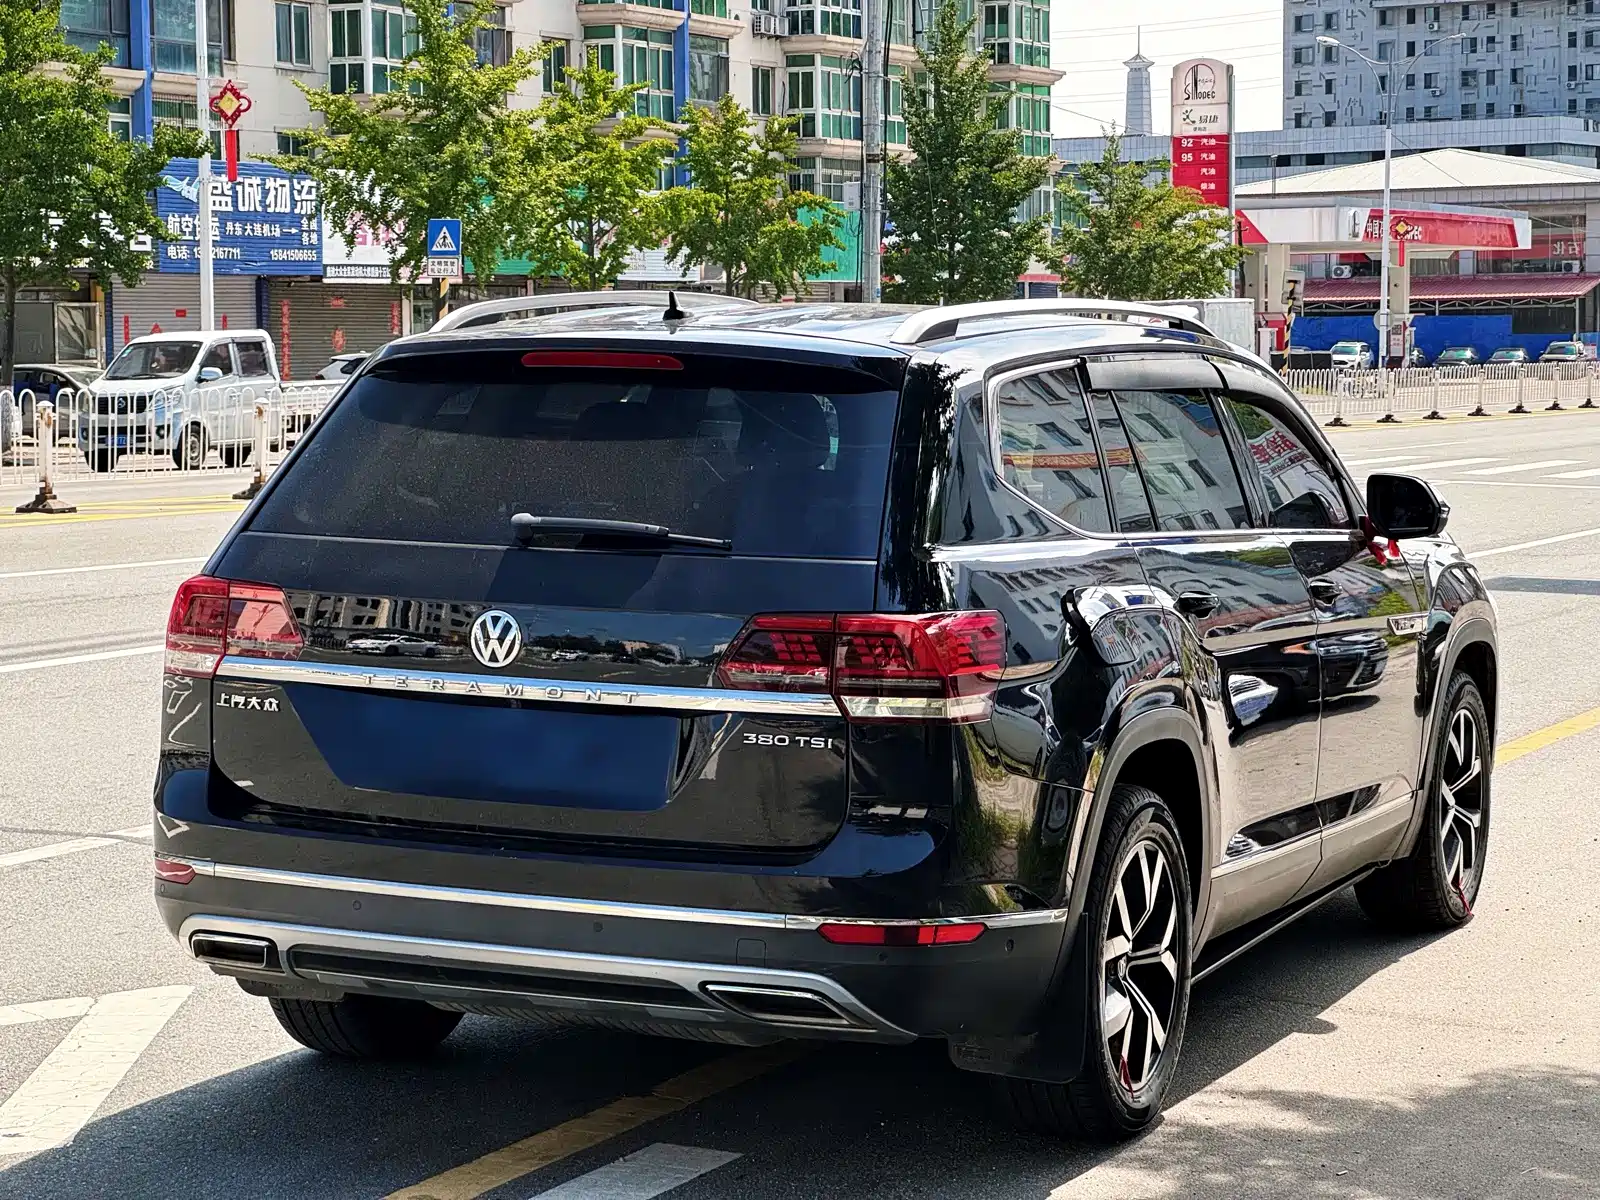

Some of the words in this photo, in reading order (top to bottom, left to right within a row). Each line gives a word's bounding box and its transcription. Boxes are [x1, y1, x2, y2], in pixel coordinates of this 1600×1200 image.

[1181, 138, 1193, 147] 92
[1200, 138, 1216, 146] 汽油
[1181, 153, 1193, 162] 95
[1200, 153, 1216, 161] 汽油
[209, 175, 317, 214] 盛诚物流
[193, 247, 240, 260] 132167711
[361, 673, 638, 704] TERAMONT
[216, 693, 279, 711] 上汽大众
[743, 733, 789, 746] 380
[795, 736, 833, 749] TSI
